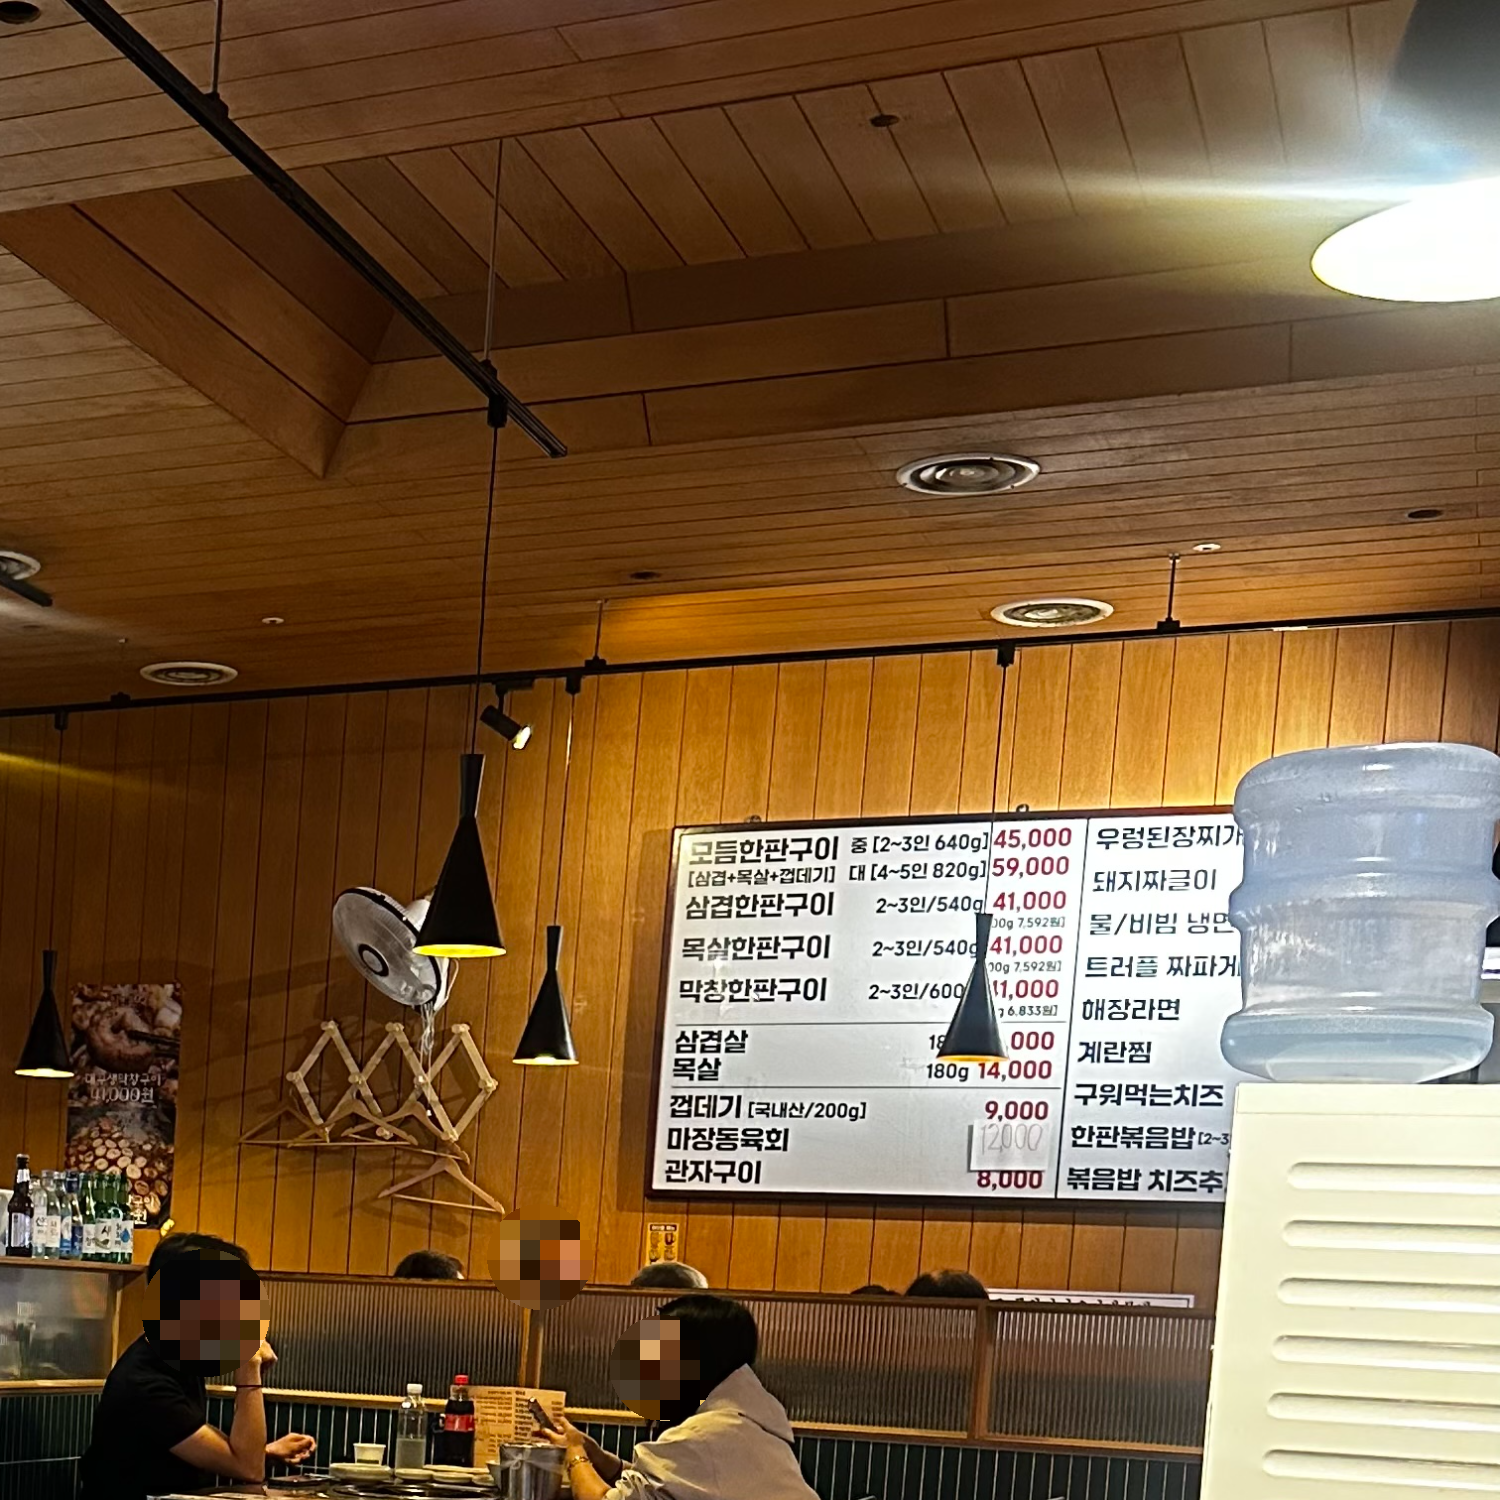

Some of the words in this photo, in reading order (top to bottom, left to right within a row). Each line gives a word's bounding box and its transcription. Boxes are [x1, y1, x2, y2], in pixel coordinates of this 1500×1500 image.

[689, 836, 839, 865] 모듬한판구이
[850, 836, 868, 854] 중
[934, 831, 989, 853] 640g]
[993, 827, 1073, 851] 45,000
[849, 864, 866, 881] 대
[932, 860, 987, 882] 820g]
[992, 856, 1070, 878] 59,000
[1093, 869, 1217, 892] 돼지짜글이
[686, 892, 835, 920] 삼겹한판구이
[875, 895, 984, 914] 2~3인/540g
[992, 890, 1067, 913] 41,000
[1090, 912, 1178, 936] 물/비빔
[682, 935, 831, 961] 목살한판구이
[989, 935, 1063, 957] 41,000
[1085, 955, 1158, 978] 트러플
[679, 977, 828, 1003] 막창한판구이
[868, 983, 966, 1001] 2~3인/600
[992, 979, 1060, 1001] 1,000
[1082, 998, 1180, 1021] 해장라면
[675, 1030, 749, 1054] 삼겹살
[1078, 1041, 1152, 1064] 계란찜
[673, 1058, 722, 1081] 목살
[926, 1063, 969, 1082] 180g
[978, 1060, 1053, 1082] 14,000
[90, 1087, 154, 1103] 41,000원
[1074, 1083, 1224, 1107] 구워먹는치즈
[669, 1095, 742, 1119] 껍데기
[747, 1101, 867, 1122] [국내산/200g]
[985, 1100, 1049, 1123] 9,000
[667, 1127, 790, 1152] 마장동육회
[1071, 1125, 1196, 1150] 한판볶음밥
[665, 1160, 762, 1185] 관자구이
[977, 1170, 1043, 1191] 8,000
[1067, 1167, 1142, 1191] 볶음밥
